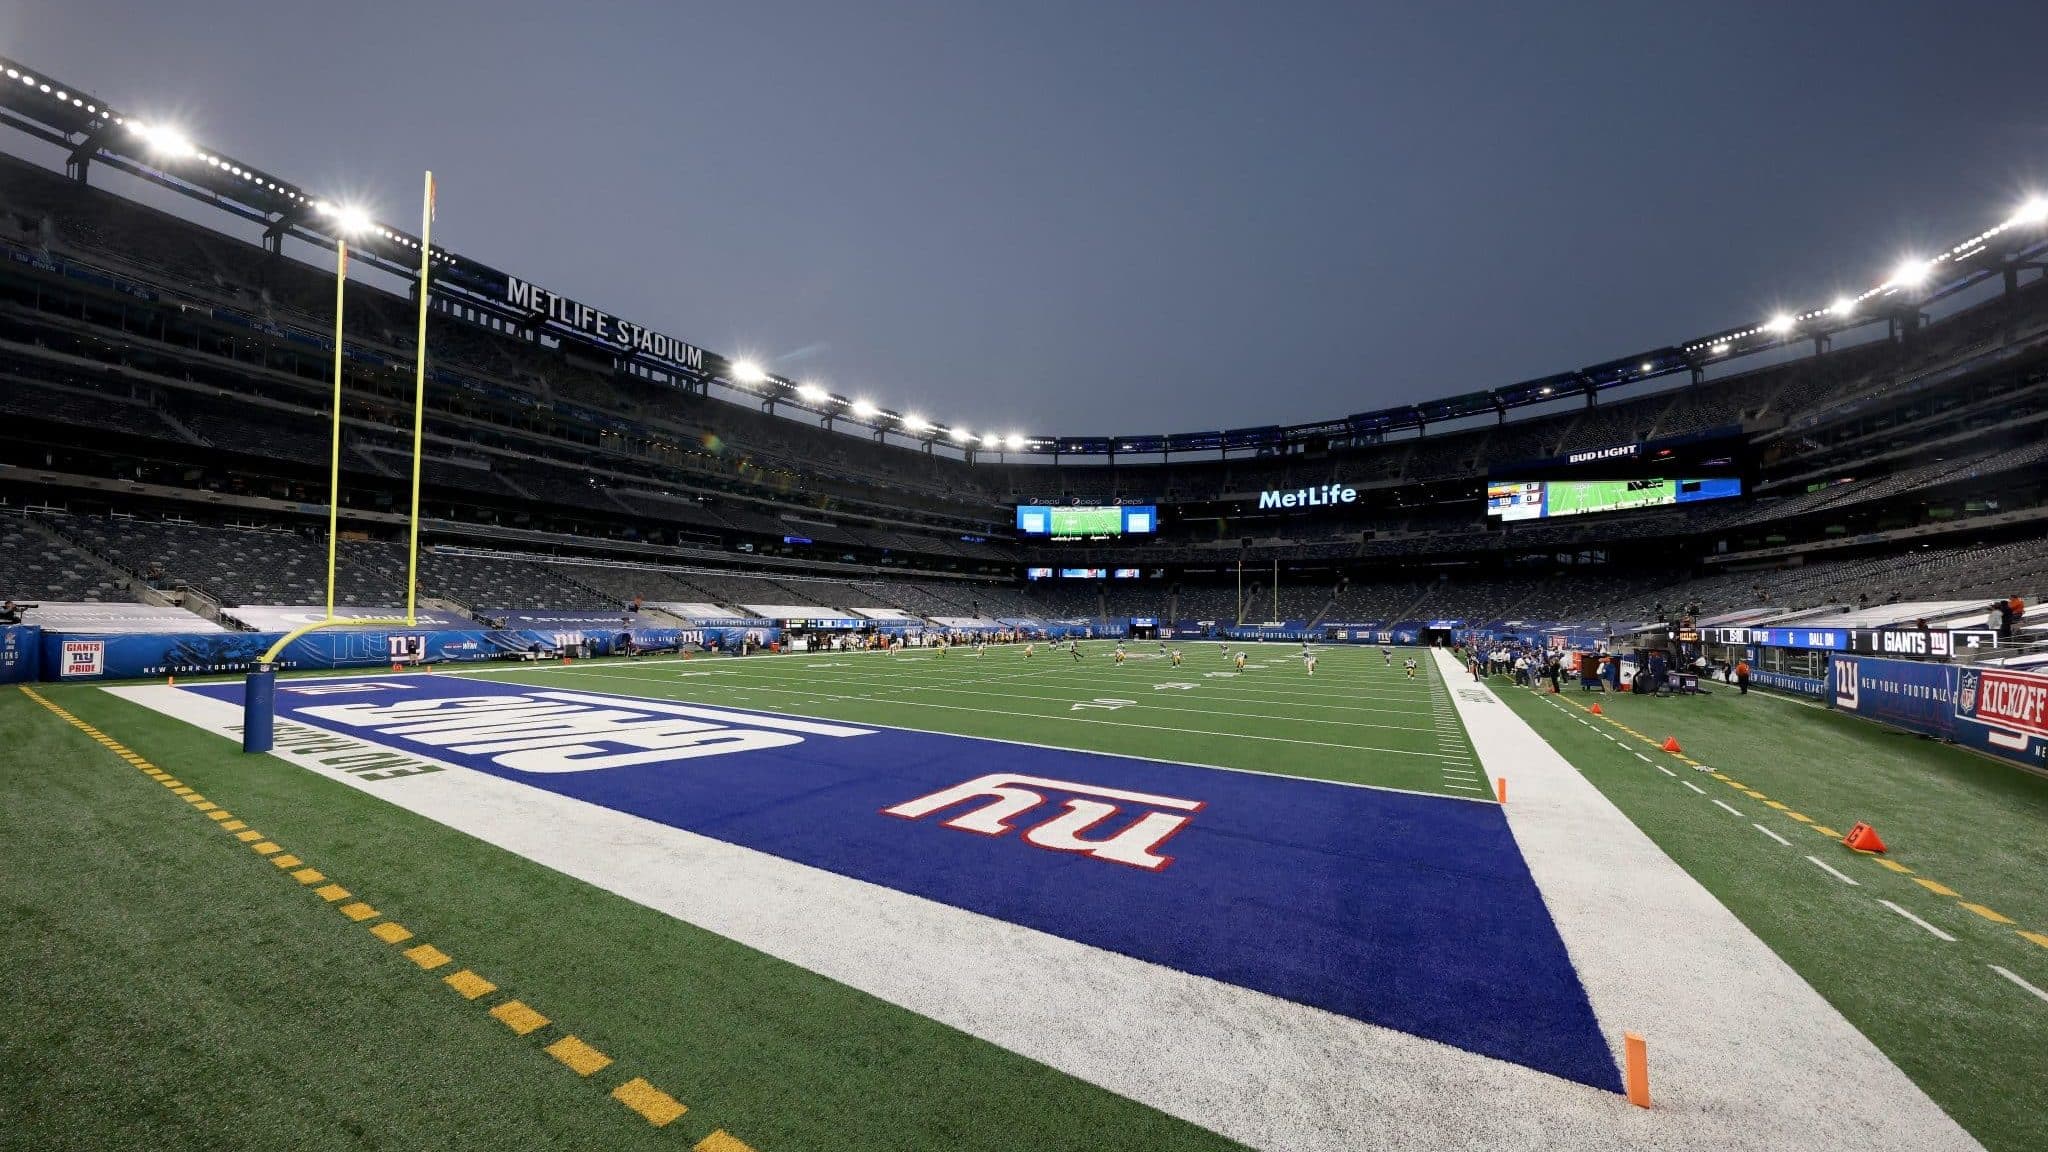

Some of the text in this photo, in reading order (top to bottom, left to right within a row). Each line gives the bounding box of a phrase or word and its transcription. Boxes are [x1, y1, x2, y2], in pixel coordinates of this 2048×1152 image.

[508, 276, 702, 370] METLIFE STADIUM
[1569, 445, 1637, 463] BUD LIGHT
[1038, 497, 1060, 505] pepsi
[1080, 497, 1101, 505] pepsi
[1121, 497, 1144, 505] pepsi
[1259, 484, 1357, 509] MetLife
[66, 643, 100, 652] GIANTS
[1809, 632, 1825, 646] BALL
[1872, 634, 1878, 650] 0
[1884, 631, 1926, 654] GIANTS
[68, 664, 96, 673] PRIDE
[143, 666, 166, 674] NEW
[174, 665, 200, 673] YORK
[1861, 677, 1877, 690] NEW
[1880, 680, 1899, 694] YORK
[1903, 683, 1947, 702] FOOTBALL
[1981, 679, 2047, 724] KICKOFF
[318, 752, 448, 782] END
[1846, 825, 1864, 844] G
